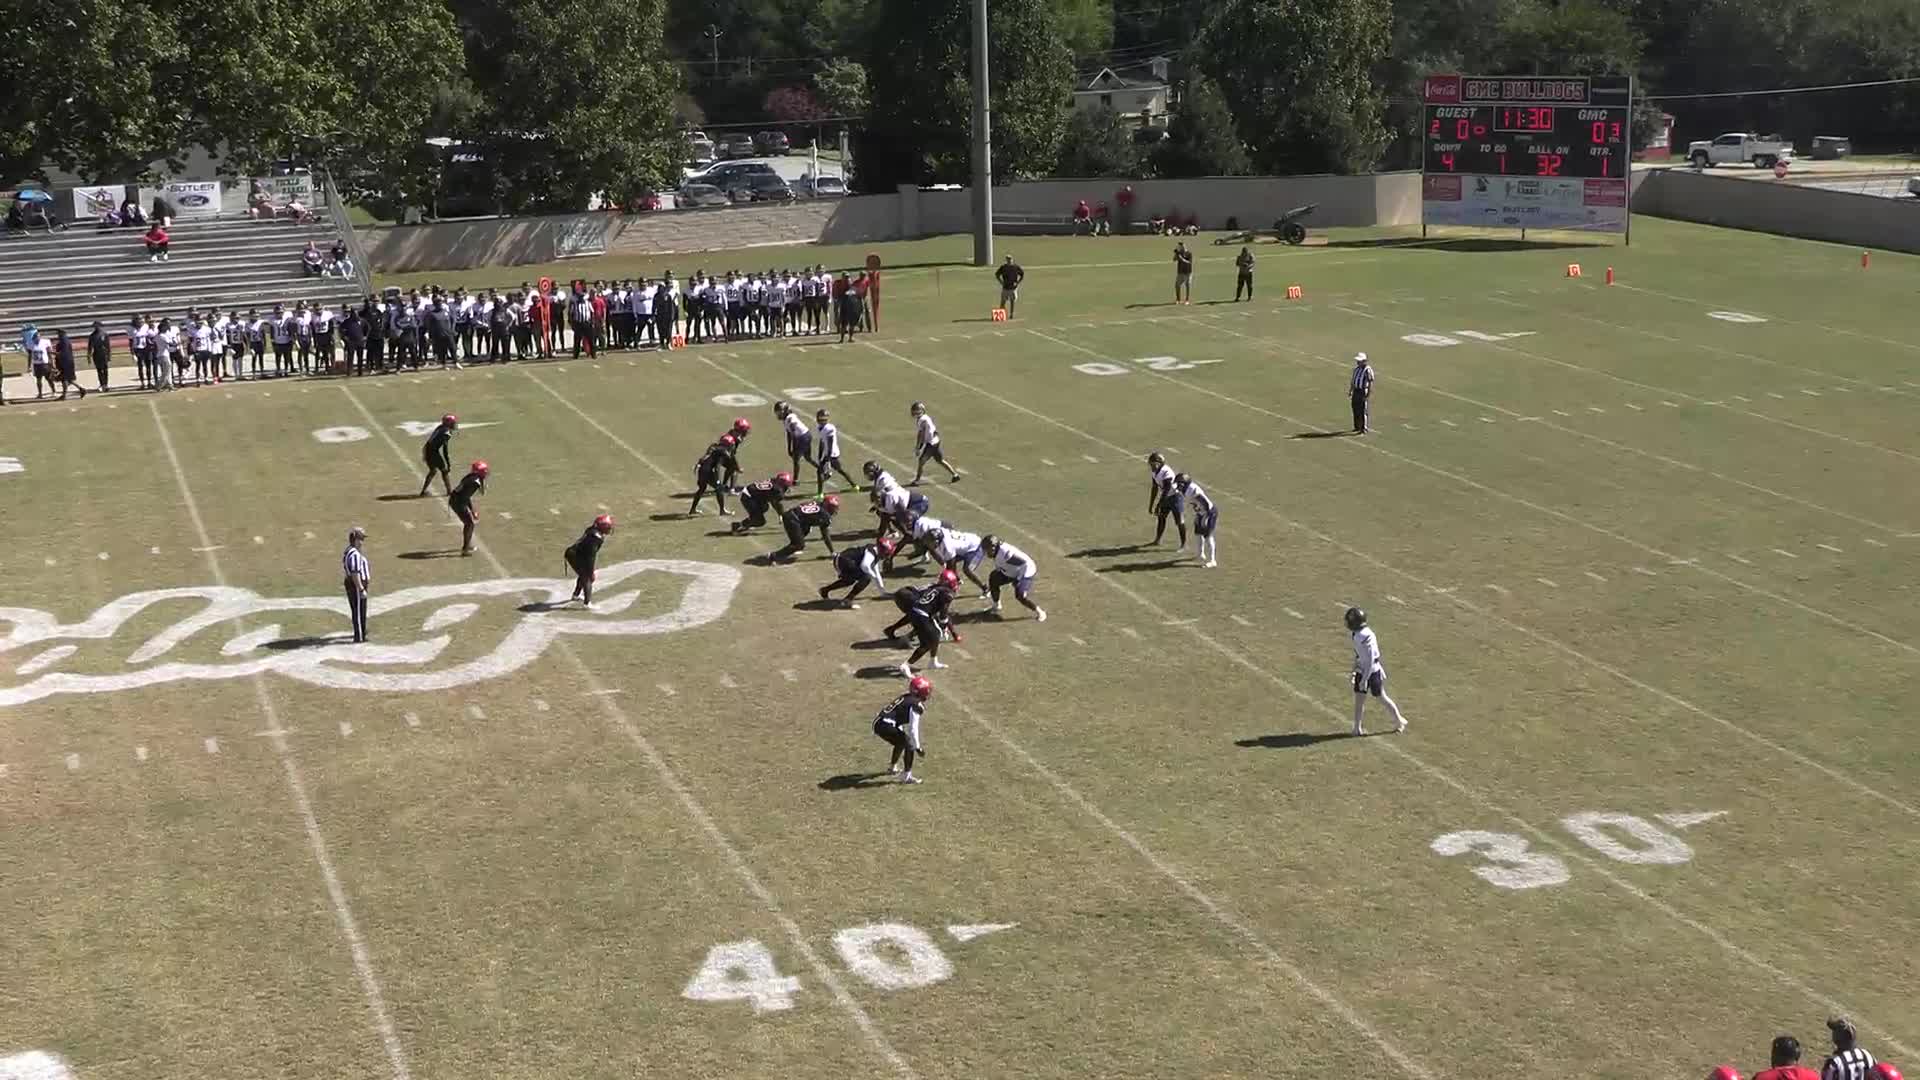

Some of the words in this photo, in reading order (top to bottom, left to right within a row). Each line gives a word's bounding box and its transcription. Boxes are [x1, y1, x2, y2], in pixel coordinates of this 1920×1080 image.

[1466, 81, 1499, 99] GMC
[1503, 81, 1584, 100] BULLDOGS
[1436, 107, 1478, 118] GUEST
[1504, 107, 1551, 129] 11:30
[1578, 109, 1608, 121] GMC
[1457, 120, 1469, 140] 0
[1592, 122, 1605, 143] 0
[1480, 144, 1491, 153] TO
[1528, 145, 1552, 154] BALL
[1555, 146, 1569, 155] ON
[1442, 154, 1454, 172] 4
[1537, 154, 1561, 175] 32
[170, 184, 215, 192] BUTLER
[993, 310, 1005, 322] 20
[1429, 810, 1695, 889] 30
[681, 923, 955, 1013] 40
